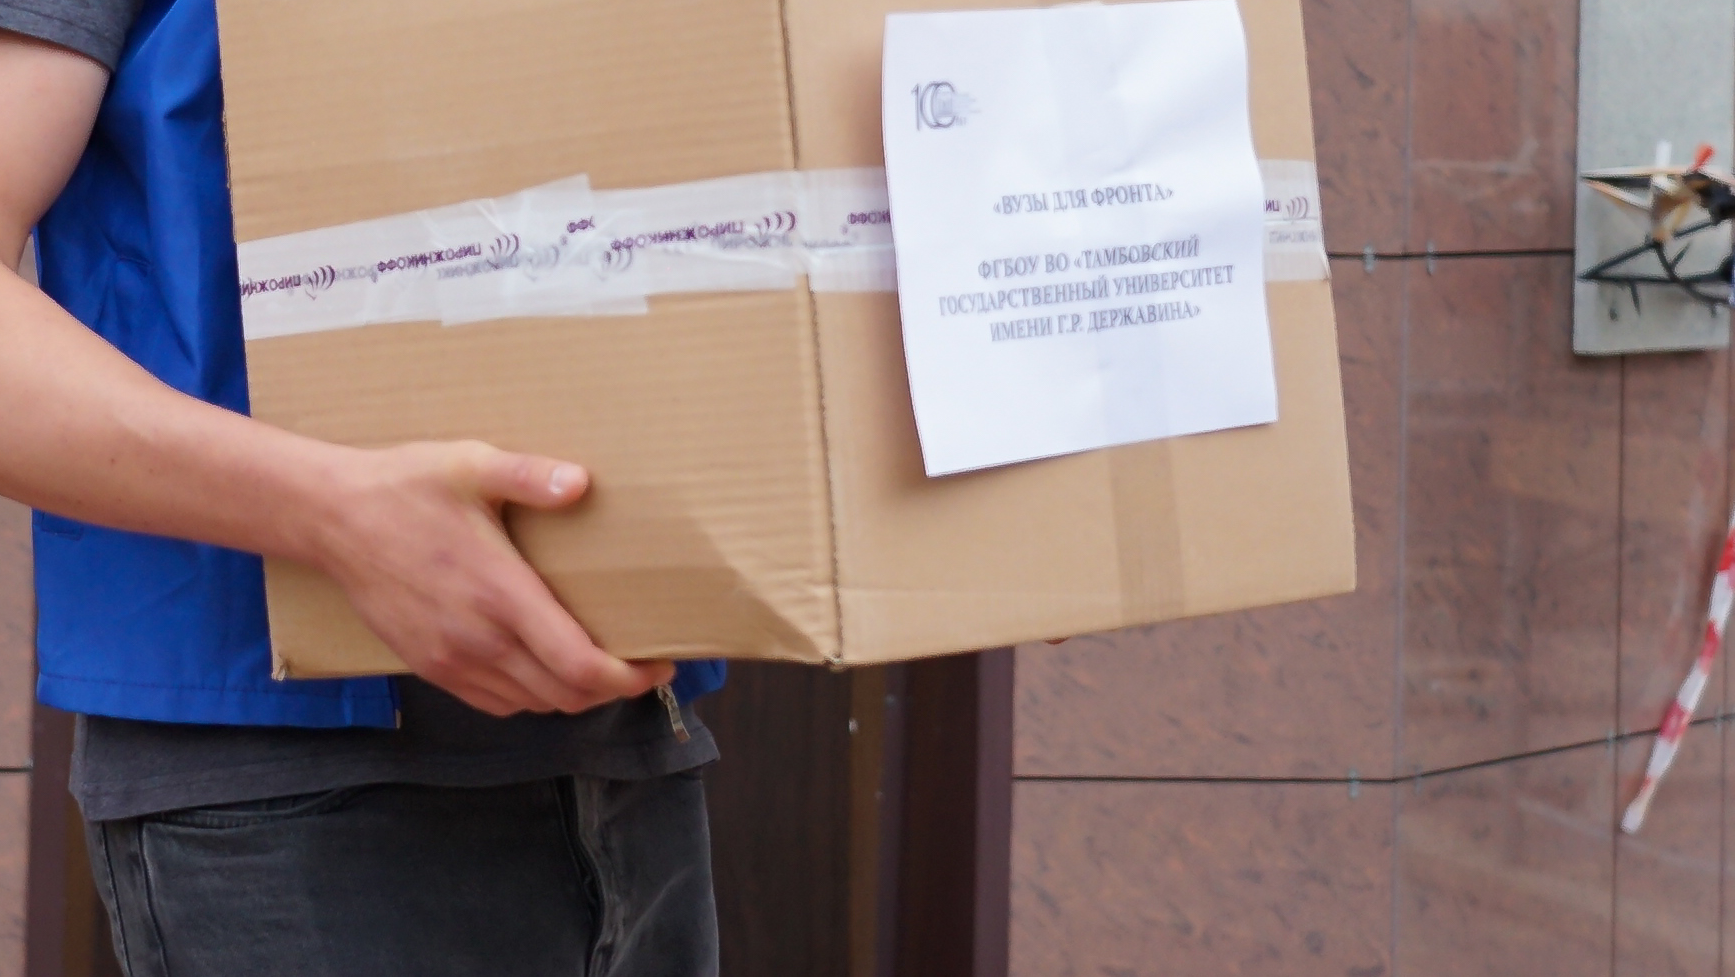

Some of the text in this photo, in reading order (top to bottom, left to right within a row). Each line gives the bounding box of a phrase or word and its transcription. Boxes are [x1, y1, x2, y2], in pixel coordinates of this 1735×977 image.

[993, 183, 1174, 214] «ВУЗЫ ДЛЯ ФРОНТА»
[978, 234, 1199, 279] ФГБОУ ВО «ТАМБОВСКИЙ
[939, 265, 1233, 316] ГОСУДАРСТВЕННЫЙ УНИВЕРСИТЕТ
[990, 301, 1201, 342] ИМЕНИ Г.Р. ДЕРЖАВИНА»
